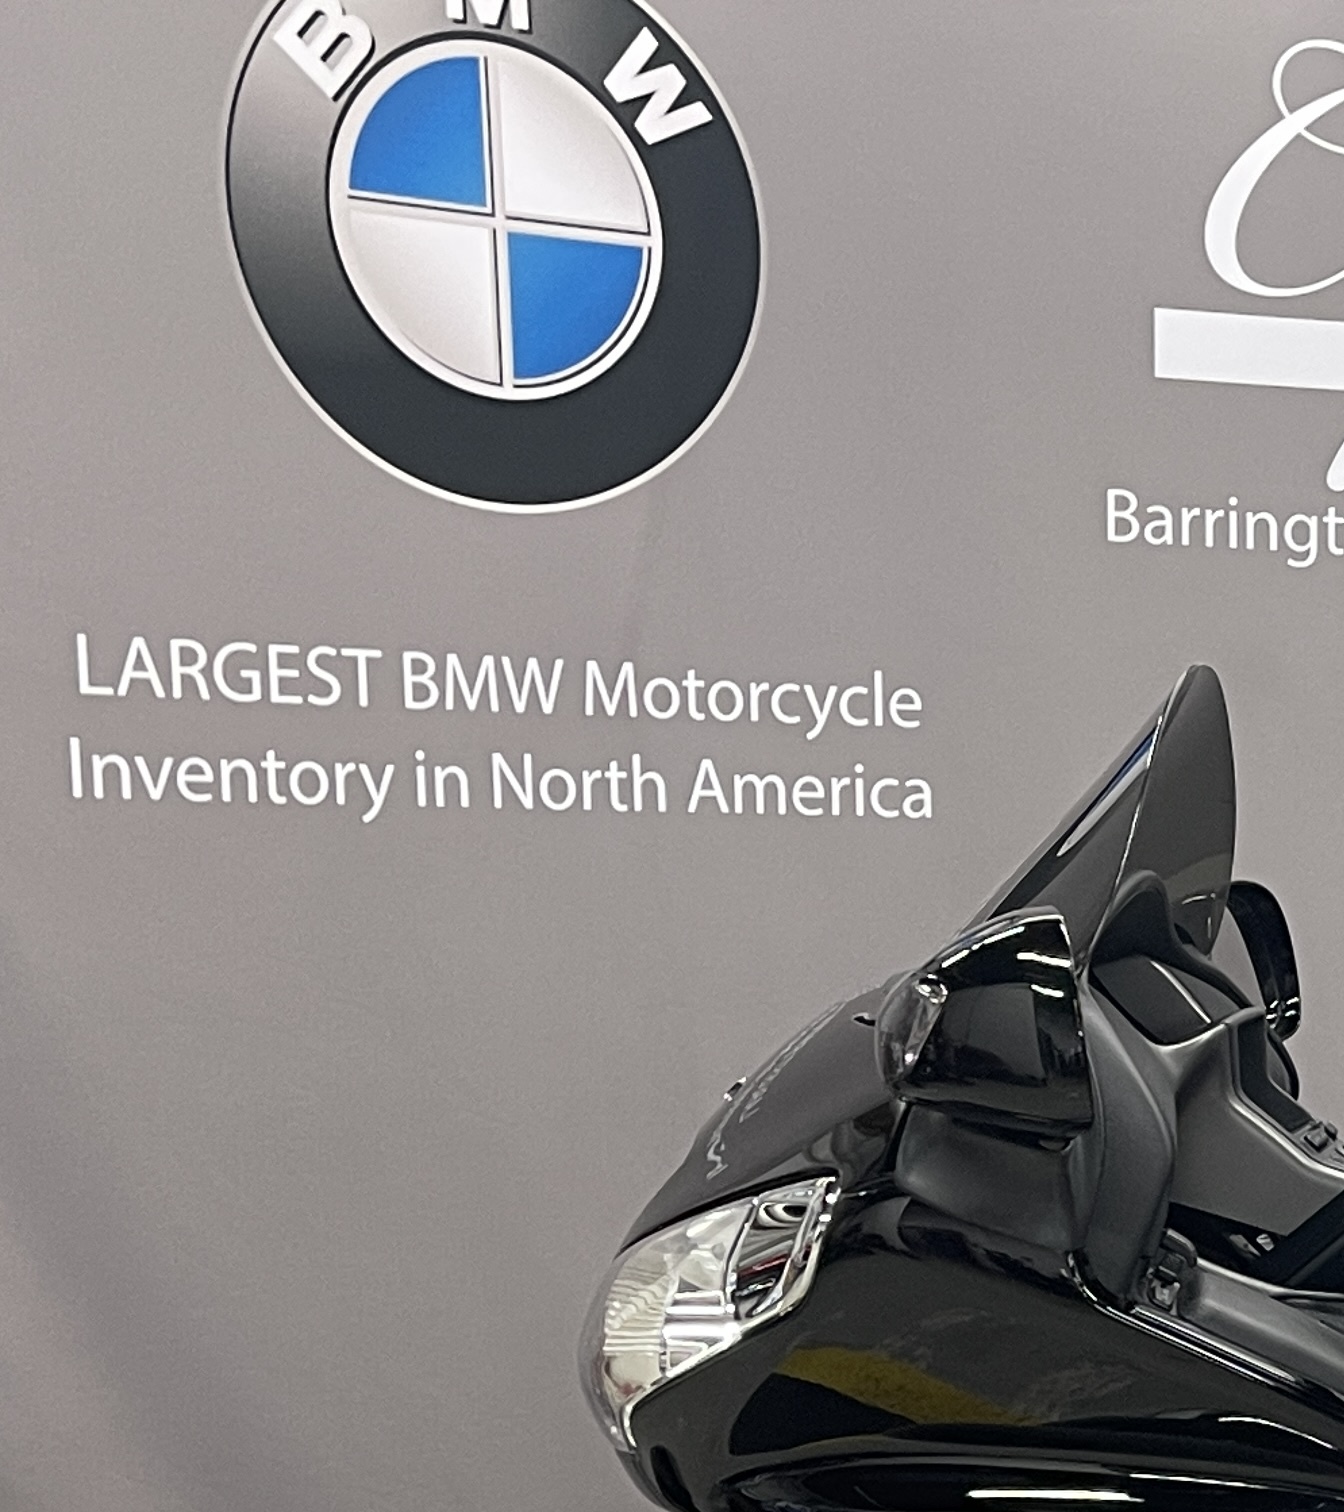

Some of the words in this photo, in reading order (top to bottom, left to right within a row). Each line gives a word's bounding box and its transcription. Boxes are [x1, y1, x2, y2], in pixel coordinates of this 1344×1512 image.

[76, 633, 383, 708] LARGEST
[402, 650, 564, 715] BMW
[585, 660, 923, 741] Motorcycle
[69, 736, 395, 824] Inventory
[414, 749, 470, 808] in
[491, 752, 667, 813] North
[687, 758, 932, 819] America
